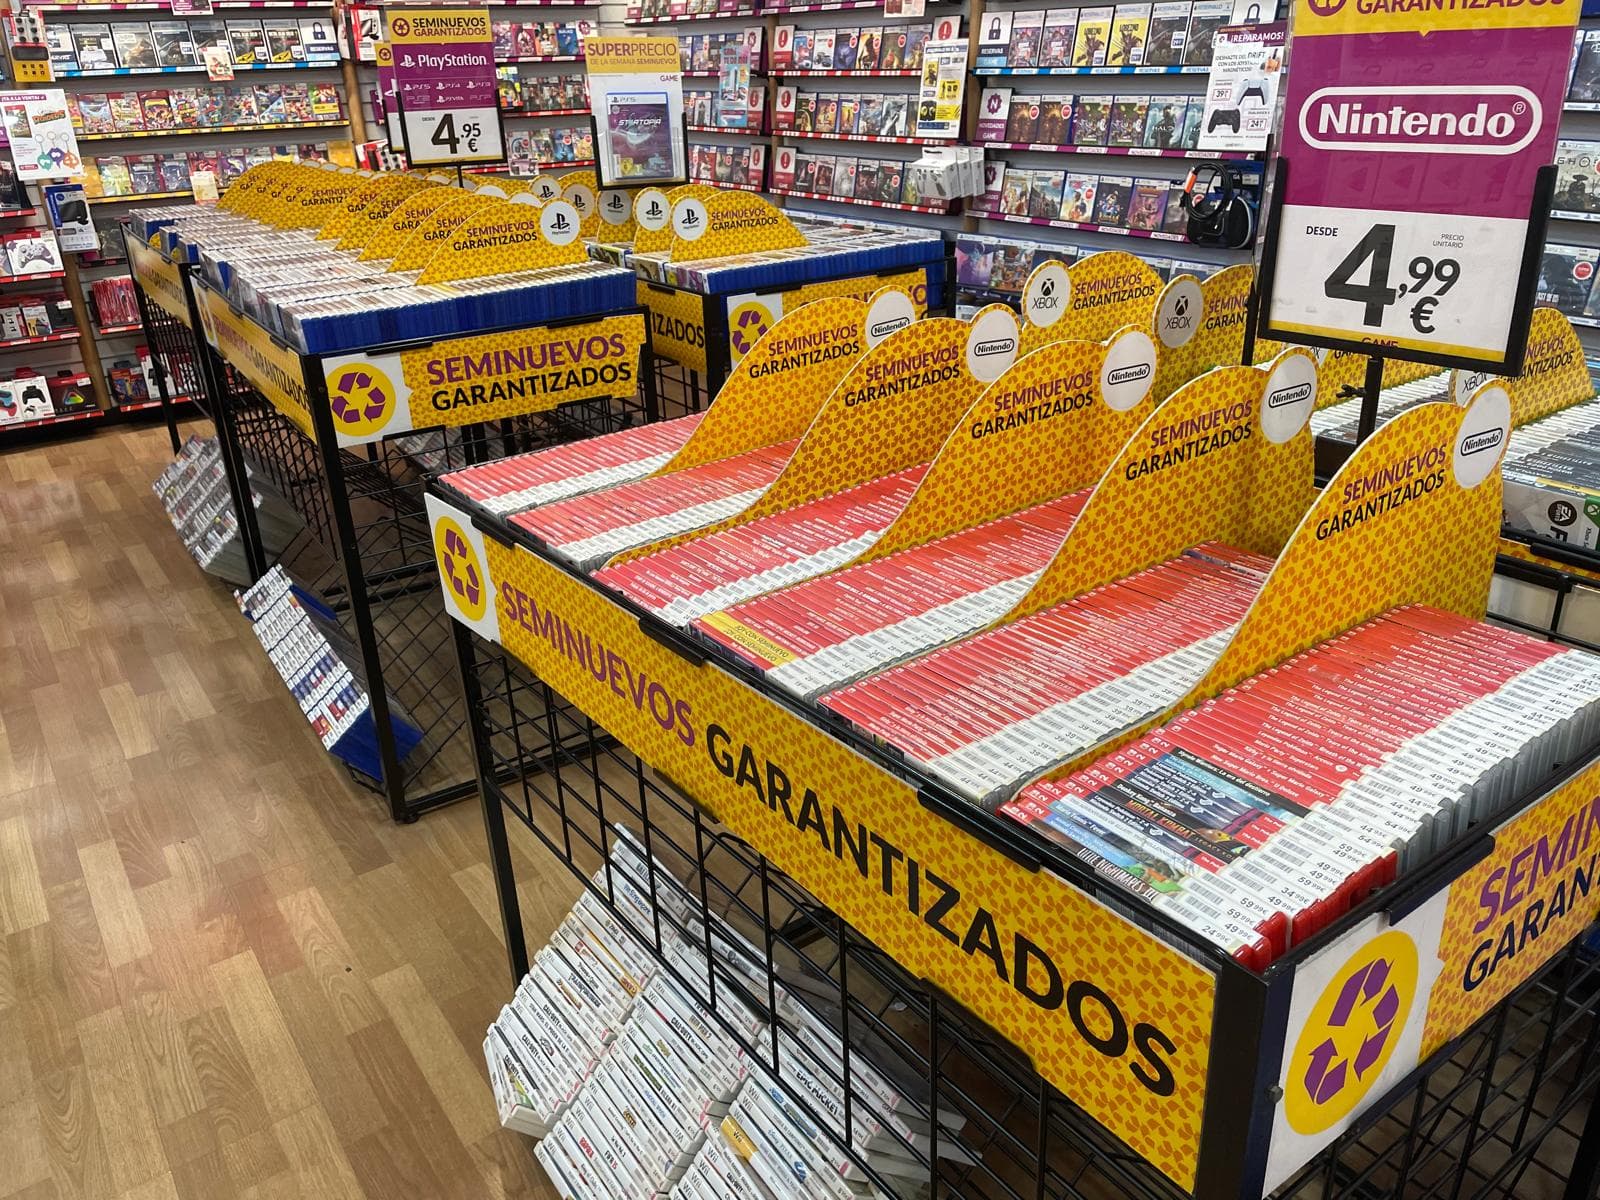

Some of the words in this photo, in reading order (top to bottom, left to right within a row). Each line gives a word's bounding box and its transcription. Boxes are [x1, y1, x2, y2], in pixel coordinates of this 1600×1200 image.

[412, 17, 486, 28] SEMINUEVOS
[414, 28, 487, 36] GARANTIZADOS
[1231, 32, 1284, 42] ¡REPARAMOS!
[588, 43, 677, 56] SUPERPRECIO
[418, 54, 487, 70] PlayStation
[1318, 103, 1516, 138] Nintendo
[468, 138, 478, 152] €
[712, 208, 766, 221] SEMINUEVOS
[712, 216, 778, 231] GARANTIZADOS
[453, 232, 537, 250] GARANTIZADOS
[466, 220, 535, 238] SEMINUEVOS
[1306, 226, 1338, 237] DESDE
[1440, 233, 1465, 241] PRECIO
[1433, 240, 1464, 248] UNITARIO
[1075, 273, 1142, 296] SEMINUEVOS
[1032, 296, 1059, 309] XBOX
[1073, 284, 1156, 310] GARANTIZADOS
[1165, 316, 1192, 329] XBOX
[1410, 296, 1440, 334] €
[652, 313, 705, 348] IZADOS
[768, 324, 858, 357] SEMINUEVOS
[426, 333, 626, 385] SEMINUEVOS
[978, 342, 1011, 354] Nintendo
[1526, 336, 1565, 358] NUEVOS
[749, 340, 860, 379] GARANTIZADOS
[866, 345, 959, 383] SEMINUEVOS
[432, 362, 632, 411] GARANTIZADOS
[844, 364, 960, 407] GARANTIZADOS
[1111, 367, 1147, 382] Nintendo
[994, 370, 1093, 412] SEMINUEVOS
[1272, 388, 1308, 404] Nintendo
[972, 390, 1093, 440] GARANTIZADOS
[1150, 400, 1253, 449] SEMINUEVOS
[1126, 422, 1251, 481] GARANTIZADOS
[1464, 433, 1499, 450] Nintendo
[1342, 444, 1448, 505] SEMINUEVOS
[1316, 468, 1445, 541] GARANTIZADOS
[755, 635, 789, 659] SEMINUEVO
[1115, 782, 1136, 798] Donkey
[1134, 792, 1151, 806] Kong
[1152, 801, 1177, 818] Bananza
[1124, 798, 1159, 822] MORTAL
[1156, 814, 1196, 841] KOMBAT
[501, 580, 696, 748] SEMINUEVOS
[707, 723, 1178, 1098] GARANTIZADOS
[1076, 845, 1099, 865] LITTLE
[1093, 856, 1146, 894] NIGHTMARES
[1463, 853, 1600, 992] GARAN
